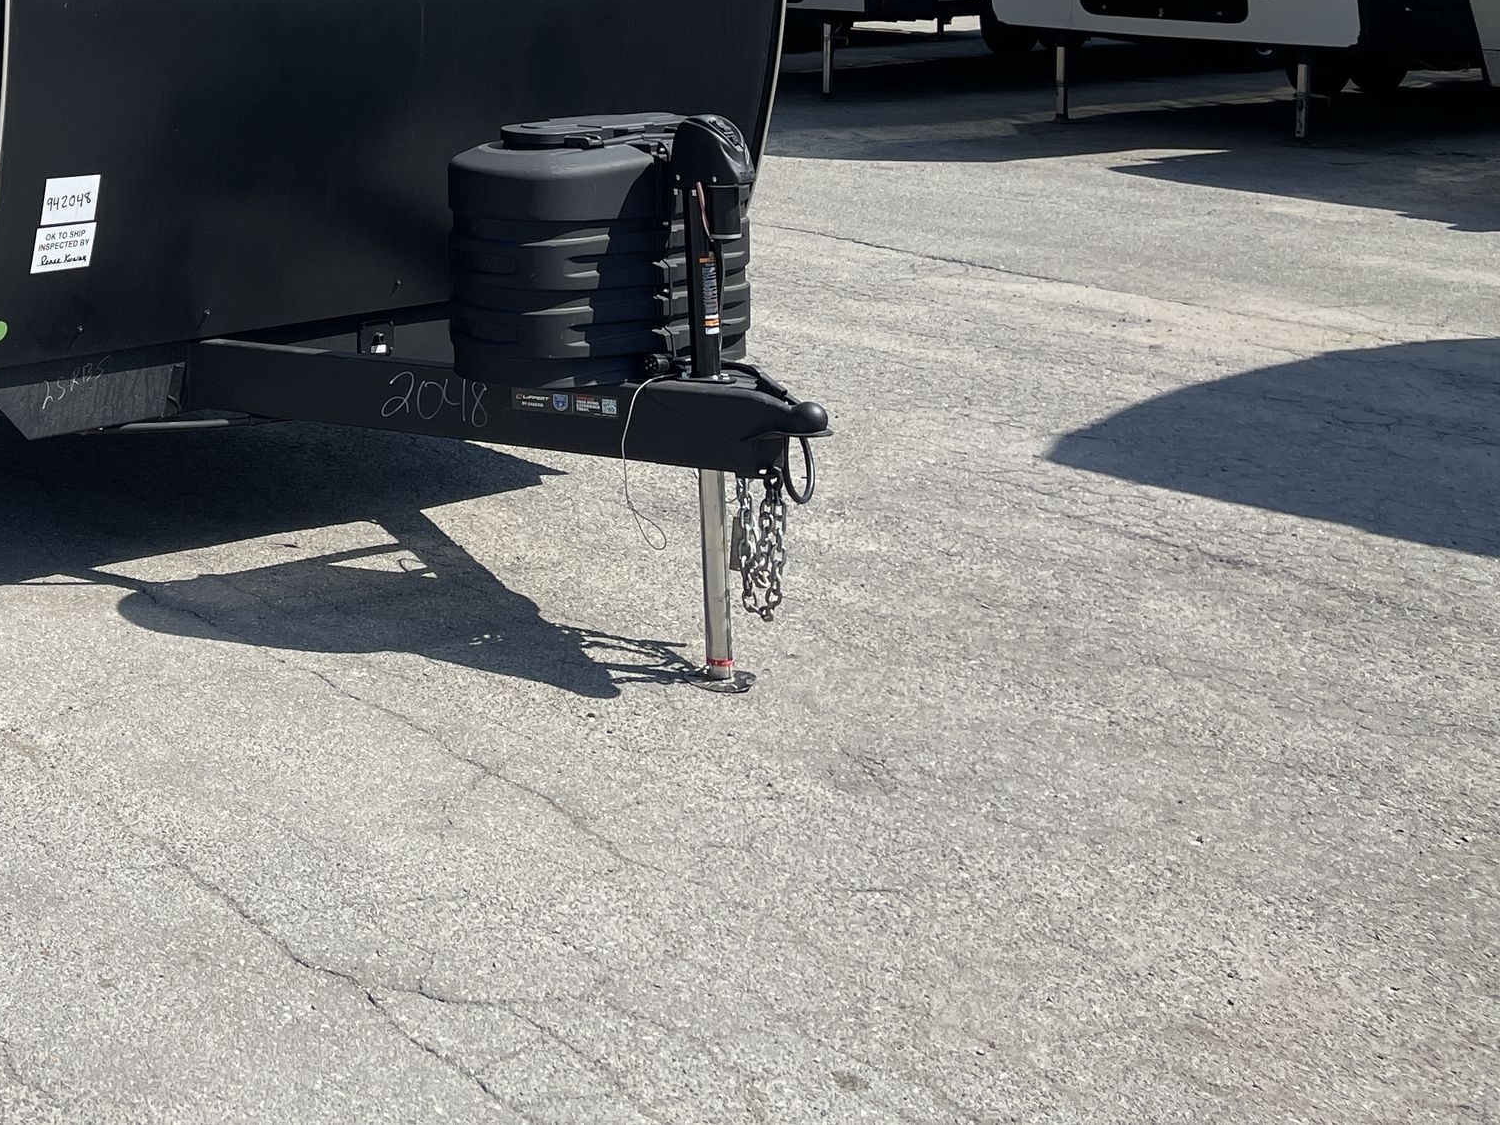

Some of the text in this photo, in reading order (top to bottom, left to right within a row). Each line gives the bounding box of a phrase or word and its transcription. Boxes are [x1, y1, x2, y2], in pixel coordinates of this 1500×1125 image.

[47, 191, 91, 211] 942048
[45, 229, 86, 241] OK TO SHIP
[38, 238, 90, 251] INSPECTED BY
[381, 371, 488, 427] 2048
[522, 394, 550, 402] LIPPERT
